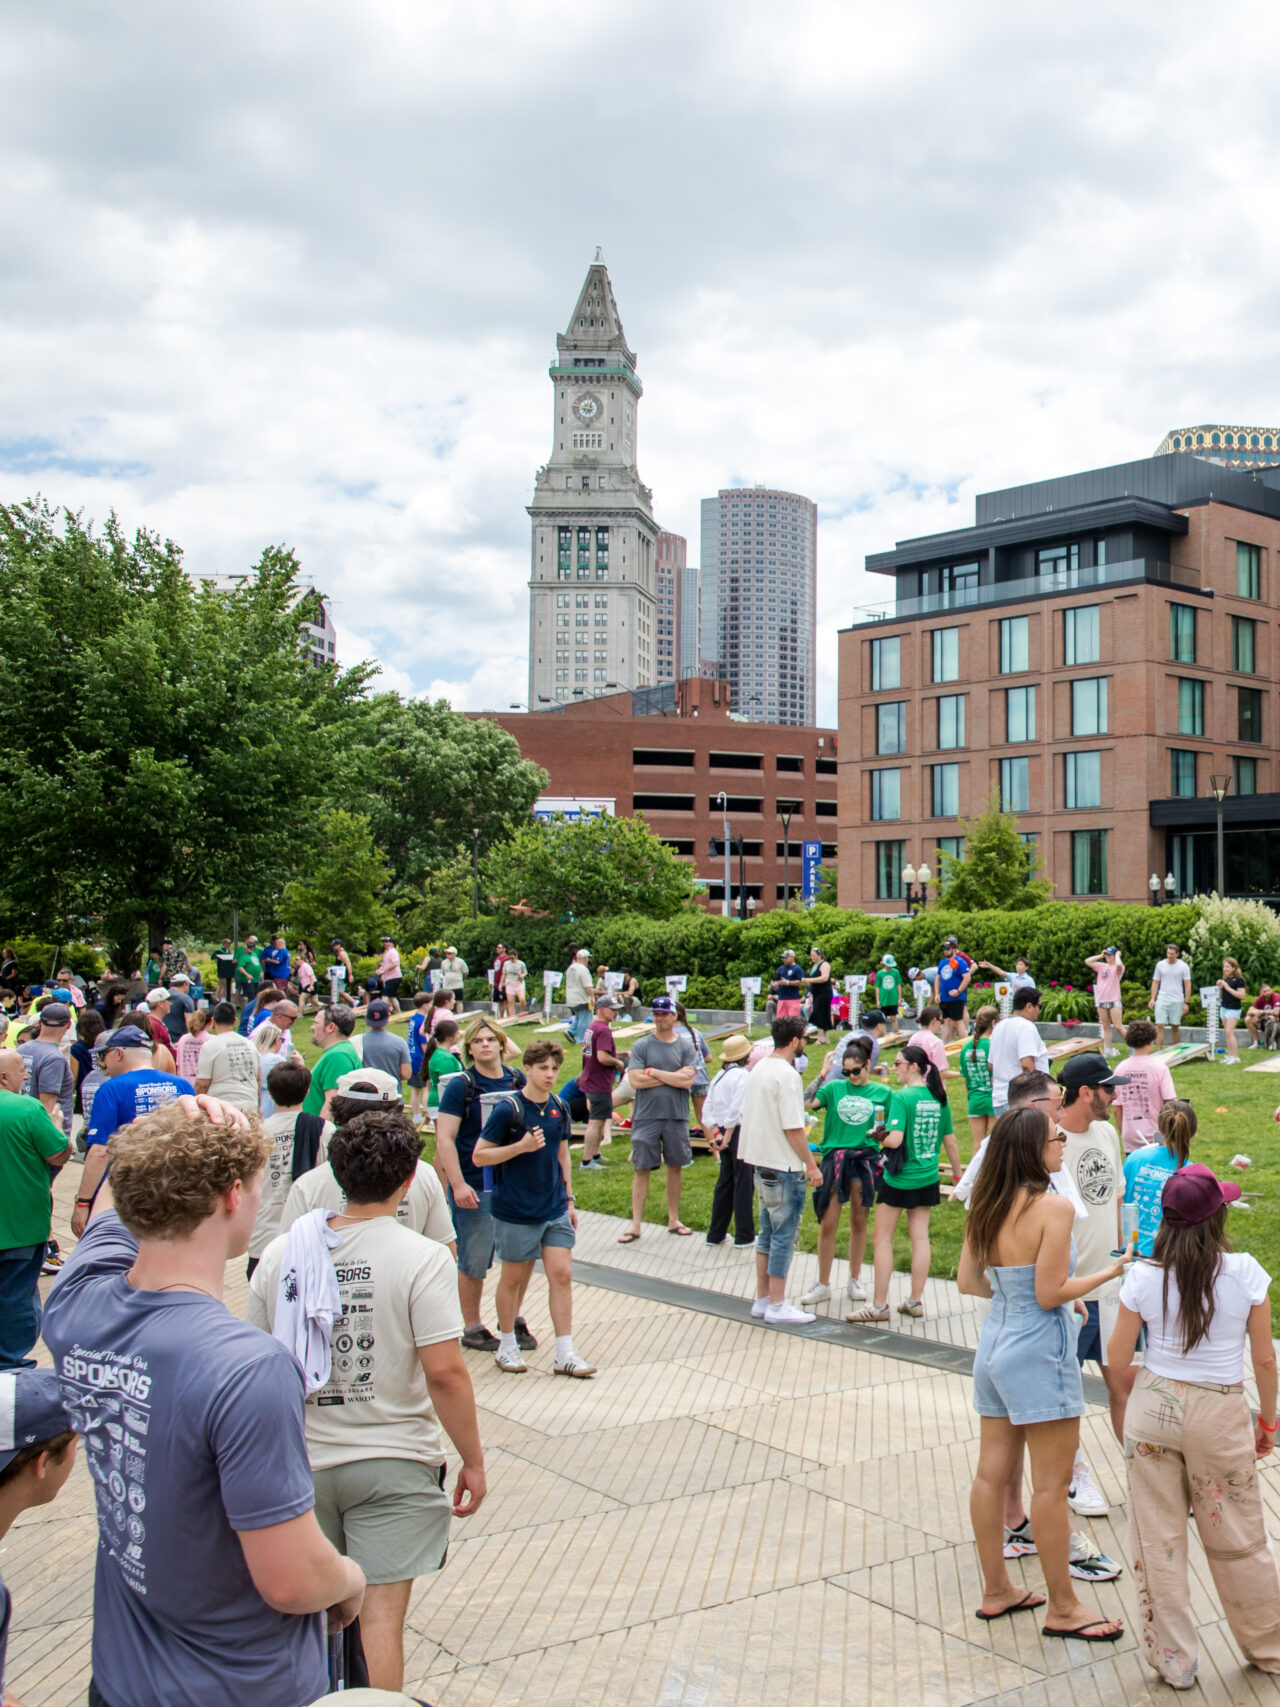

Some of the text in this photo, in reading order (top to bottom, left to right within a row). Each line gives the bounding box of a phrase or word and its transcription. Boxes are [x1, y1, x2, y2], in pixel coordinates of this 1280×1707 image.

[135, 1086, 177, 1097] SPONSORS
[336, 1266, 371, 1282] SORS
[63, 1355, 152, 1400] SPONSORS
